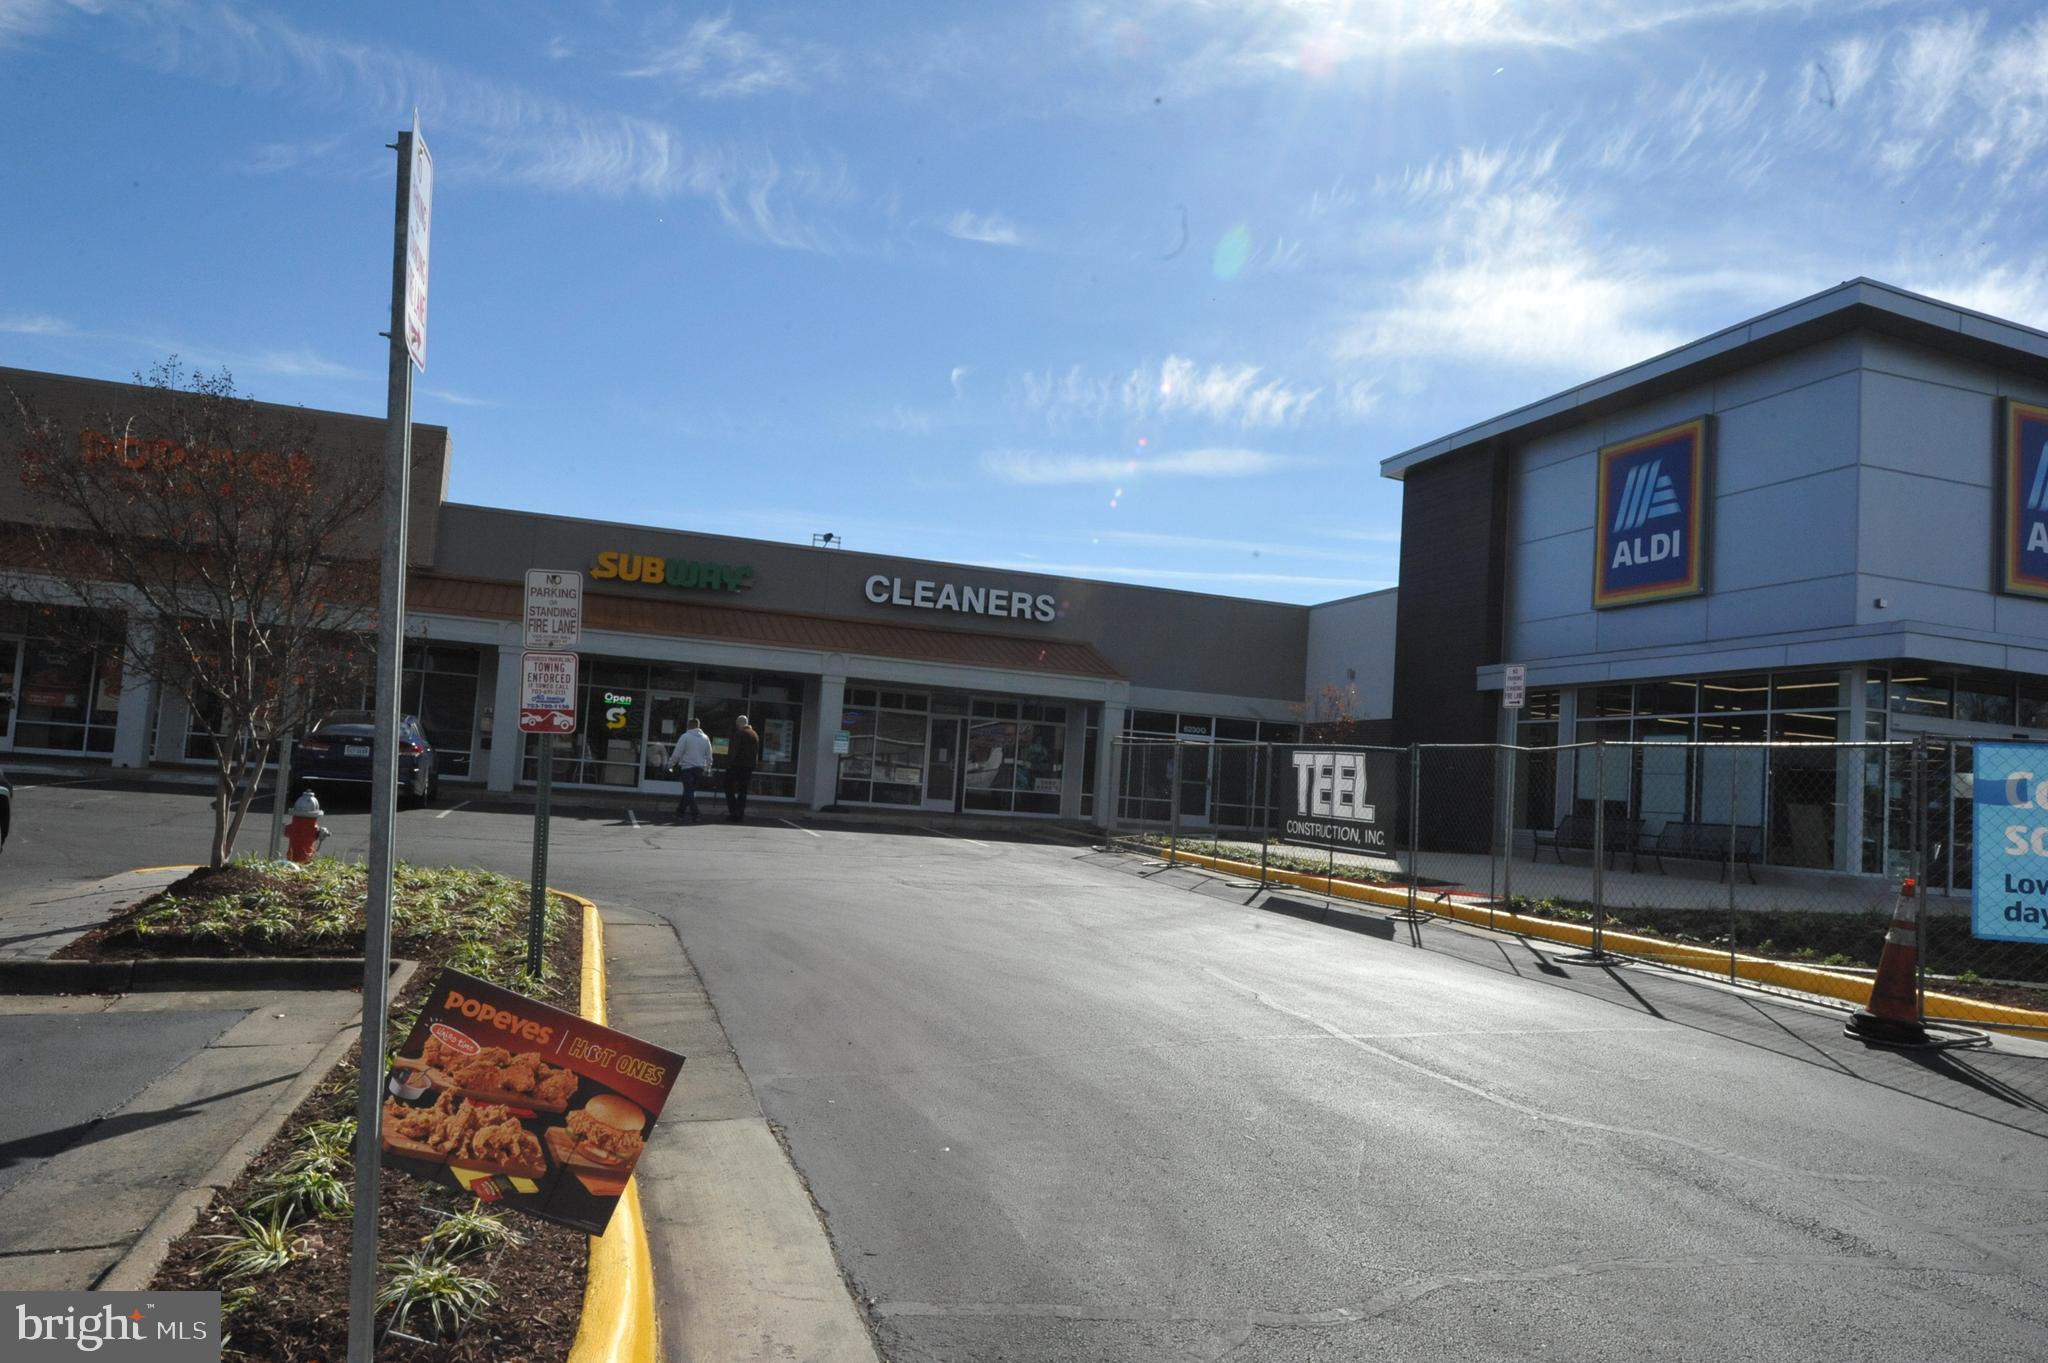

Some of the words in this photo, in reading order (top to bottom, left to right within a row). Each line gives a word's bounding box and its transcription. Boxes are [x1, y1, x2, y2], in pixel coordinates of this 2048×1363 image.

[1611, 530, 1681, 569] ALDI
[546, 574, 562, 585] NO
[590, 551, 753, 592] SUBWAY
[530, 587, 577, 599] PARKING
[865, 574, 1056, 622] CLEANERS
[529, 606, 577, 618] STANDING
[528, 618, 549, 633] FIRE
[552, 619, 576, 634] LANE
[534, 662, 565, 673] TOWING
[527, 672, 571, 684] ENFORCED
[604, 692, 632, 704] Open
[1292, 751, 1375, 823] TEEL
[1286, 820, 1361, 844] CONSTRUCTION,
[1364, 829, 1385, 846] INC.
[569, 1037, 616, 1068] HOT
[616, 1056, 666, 1086] ONES
